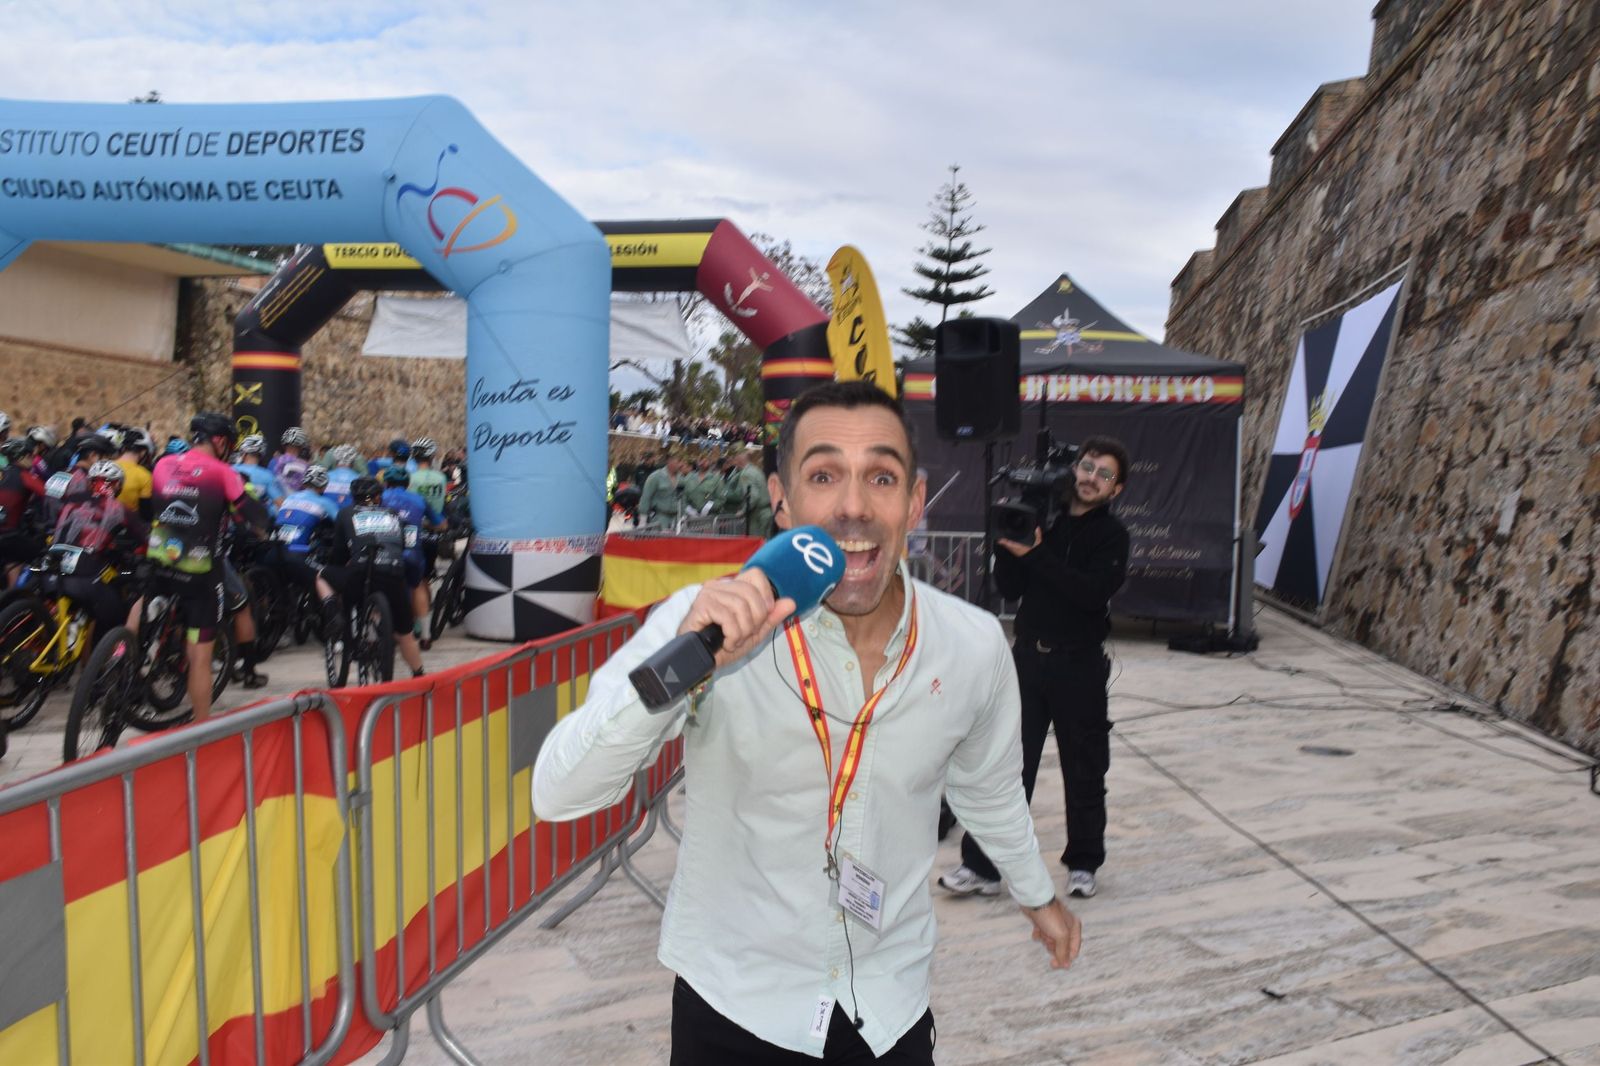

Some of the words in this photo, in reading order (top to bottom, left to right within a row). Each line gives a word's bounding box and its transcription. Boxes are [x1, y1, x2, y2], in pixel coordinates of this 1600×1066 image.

[0, 129, 99, 156] STITUTO
[107, 127, 183, 156] CEUTÍ
[185, 131, 221, 157] DE
[226, 128, 366, 156] DEPORTES
[1, 177, 86, 199] CIUDAD
[93, 176, 223, 202] AUTÓNOMA
[227, 180, 259, 201] DE
[265, 179, 343, 201] CEUTA
[334, 246, 379, 257] TERCIO
[547, 385, 576, 401] es
[1025, 373, 1214, 402] DEPORTIVO
[473, 421, 577, 463] Deporte
